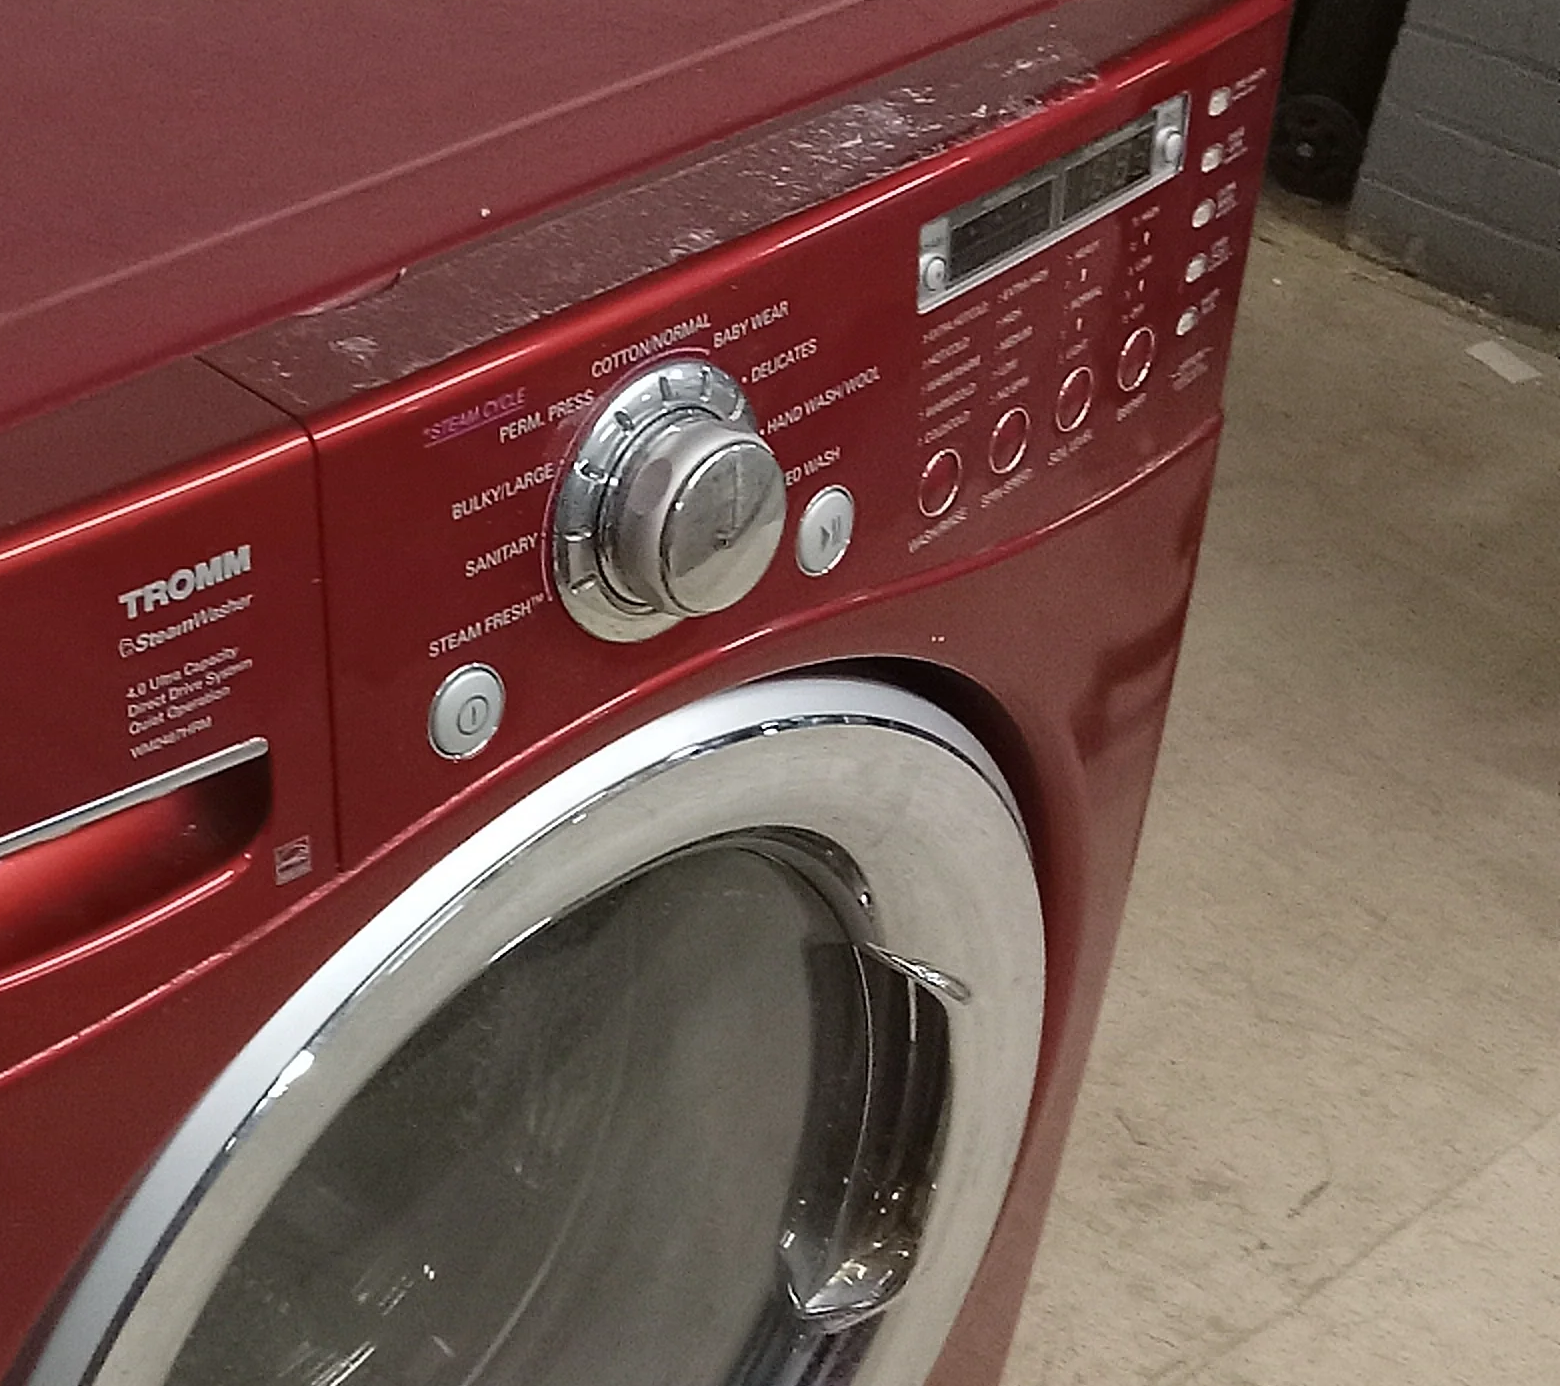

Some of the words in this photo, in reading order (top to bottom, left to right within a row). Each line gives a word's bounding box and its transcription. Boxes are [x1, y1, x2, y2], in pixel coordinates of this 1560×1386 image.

[591, 313, 712, 379] COTTON/NORMAL
[713, 317, 748, 348] BABY
[750, 300, 789, 331] WEAR
[751, 338, 818, 383] DELICATES
[430, 405, 481, 440] STEAM
[483, 386, 526, 418] CYCLE
[498, 411, 546, 445] PERM.
[548, 388, 595, 422] PRESS
[766, 405, 803, 435] HAND
[803, 365, 881, 416] WASH/WOOL
[803, 445, 841, 476] WASH
[451, 462, 556, 520] BULKY/LARGE
[465, 532, 539, 578] SANITARY
[117, 544, 252, 620] TROMM
[428, 621, 483, 658] STEAM
[168, 680, 203, 701] Drive
